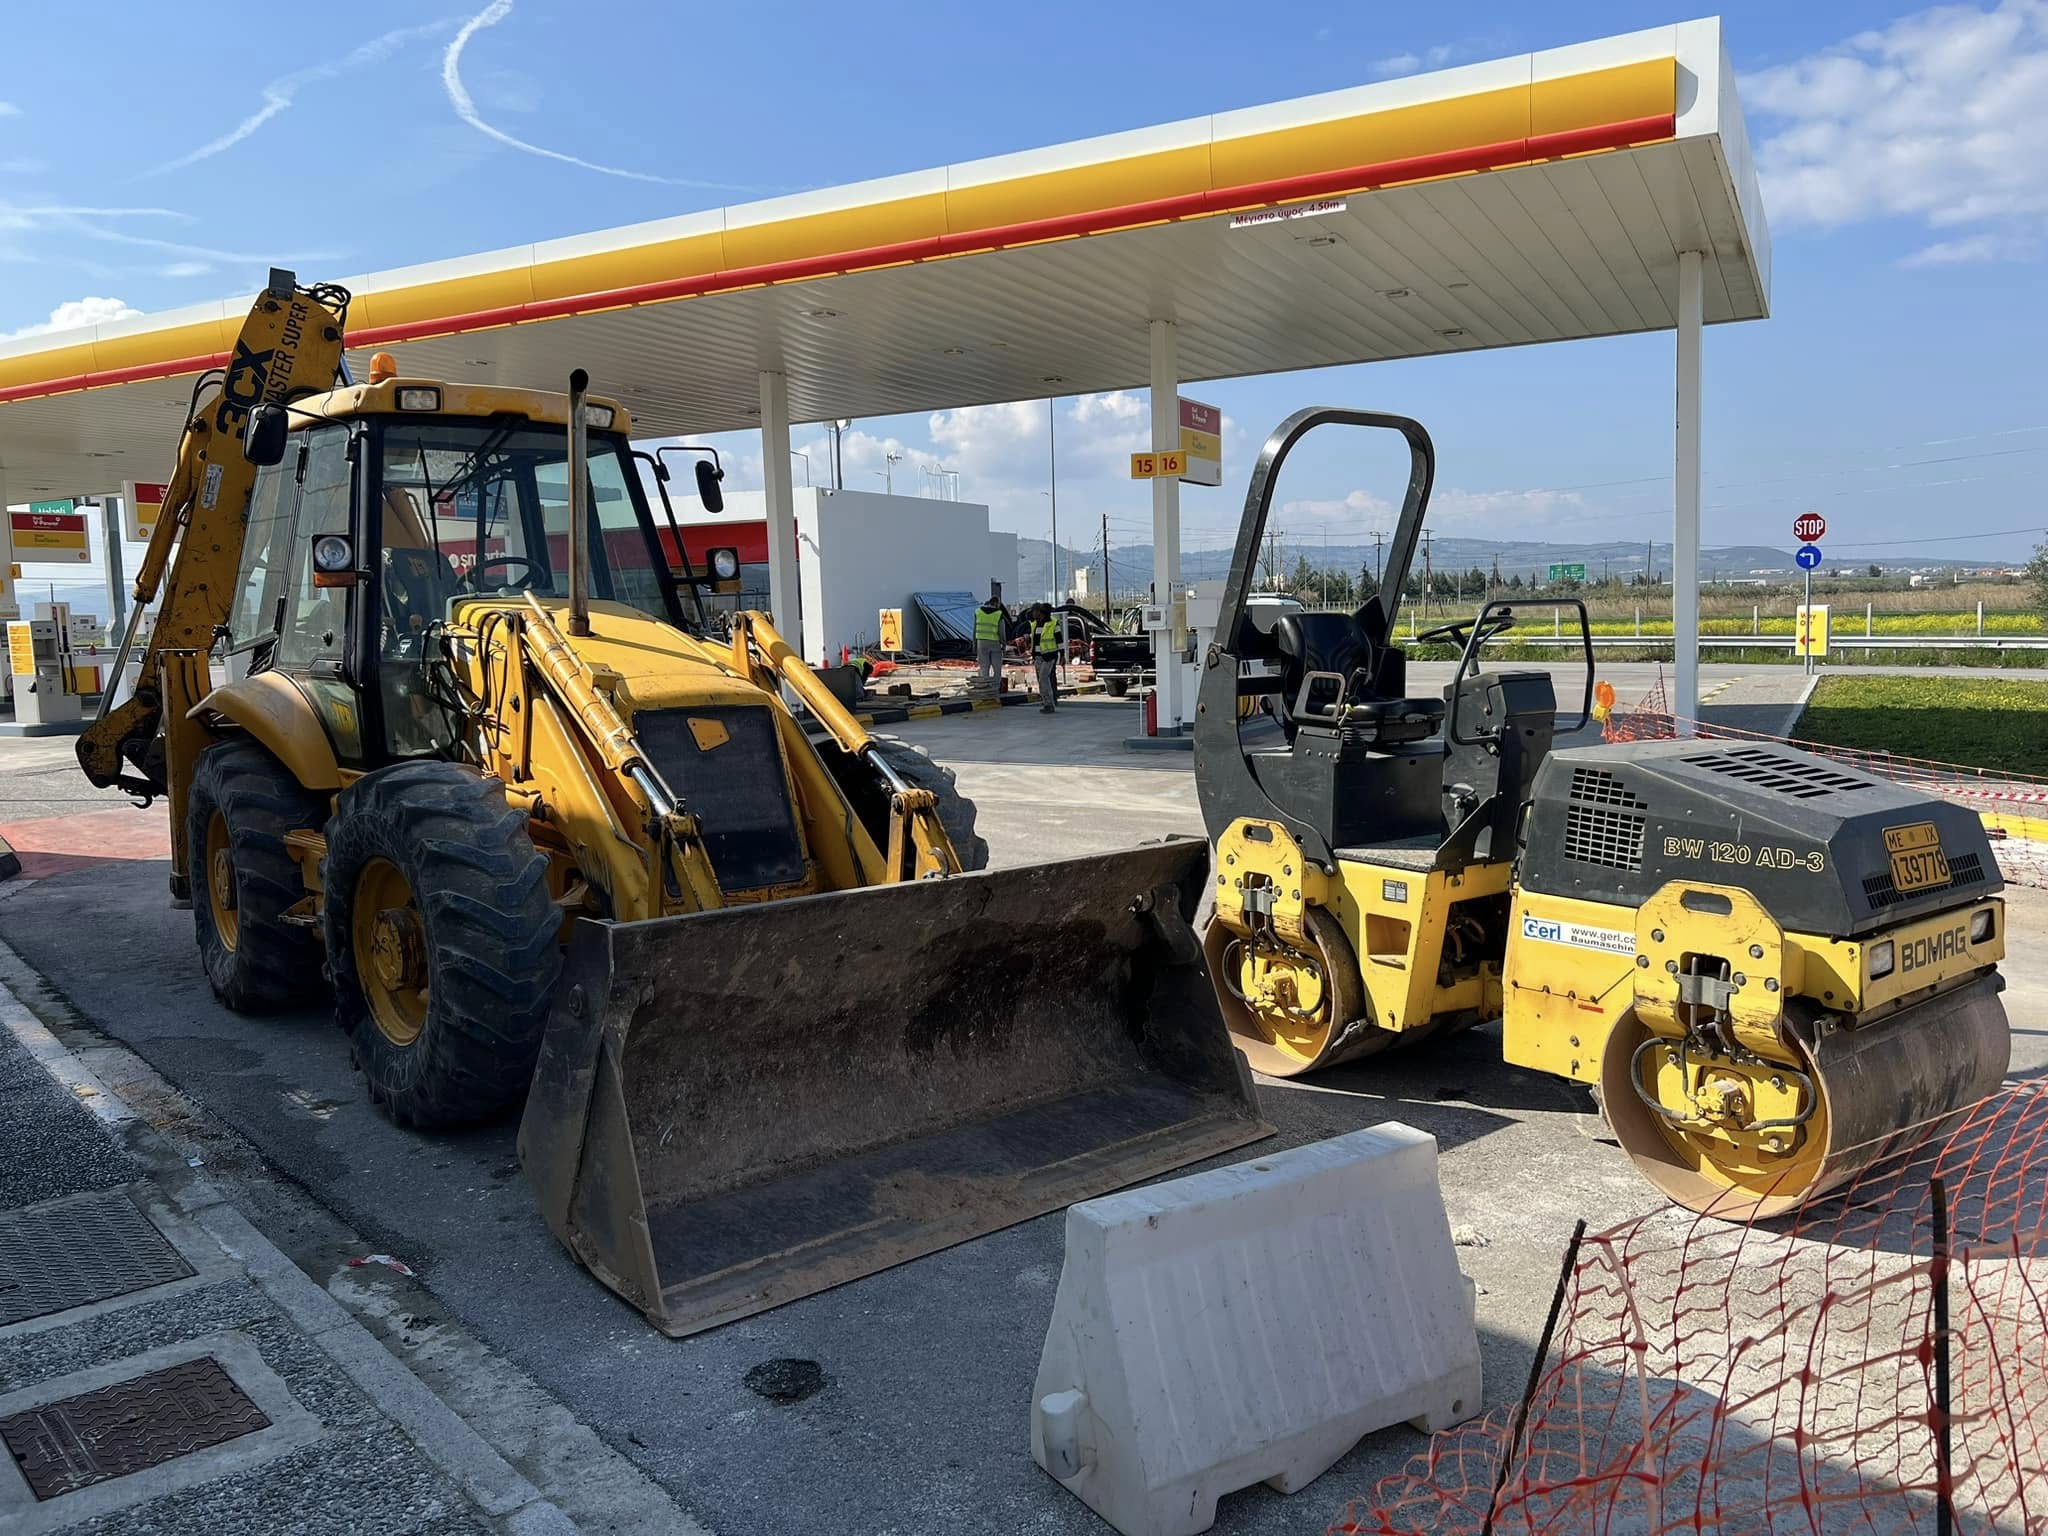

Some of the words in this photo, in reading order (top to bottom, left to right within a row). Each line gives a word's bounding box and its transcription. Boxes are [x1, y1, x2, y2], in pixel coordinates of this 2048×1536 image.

[263, 349, 296, 403] ASTER
[281, 301, 309, 350] SUPER
[215, 338, 275, 441] 3CX
[1136, 459, 1153, 473] 15
[1161, 456, 1178, 471] 16
[1795, 519, 1824, 536] STOP
[1887, 832, 1903, 848] ME
[1925, 829, 1937, 843] IX
[1663, 836, 1704, 859] BW
[1708, 841, 1752, 865] 120
[1755, 846, 1825, 873] AD-3
[1892, 849, 1949, 887] 139778
[1524, 918, 1561, 940] Gerl
[1571, 935, 1636, 952] Baumaschin
[1901, 926, 1968, 973] BOMAG
